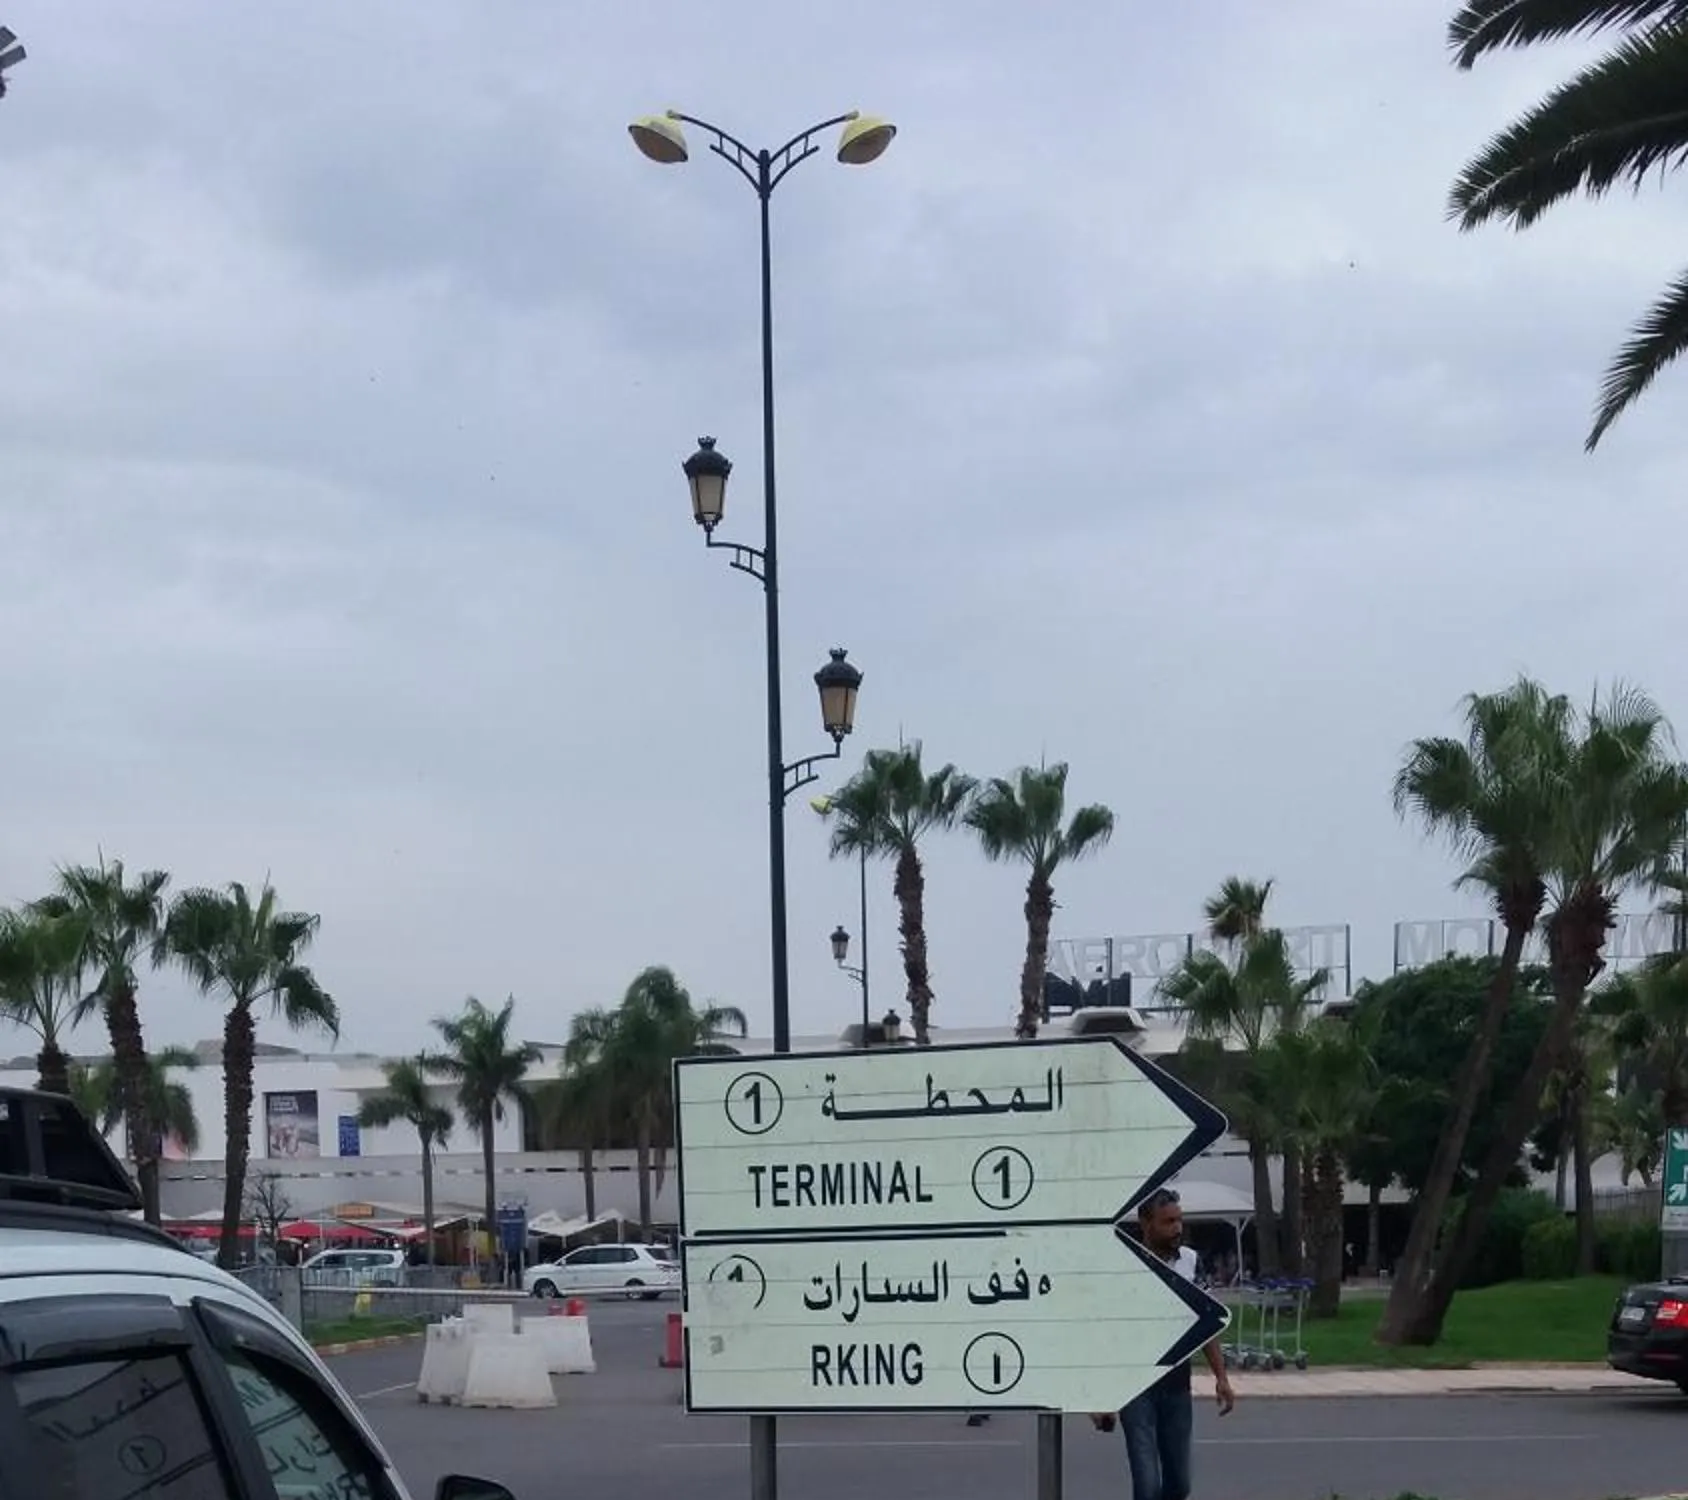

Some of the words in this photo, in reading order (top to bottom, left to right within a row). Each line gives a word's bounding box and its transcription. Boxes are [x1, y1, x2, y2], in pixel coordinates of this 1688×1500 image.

[822, 1066, 1063, 1121] المحطة
[748, 1160, 933, 1208] TERMINAL
[812, 1343, 924, 1386] RKING
